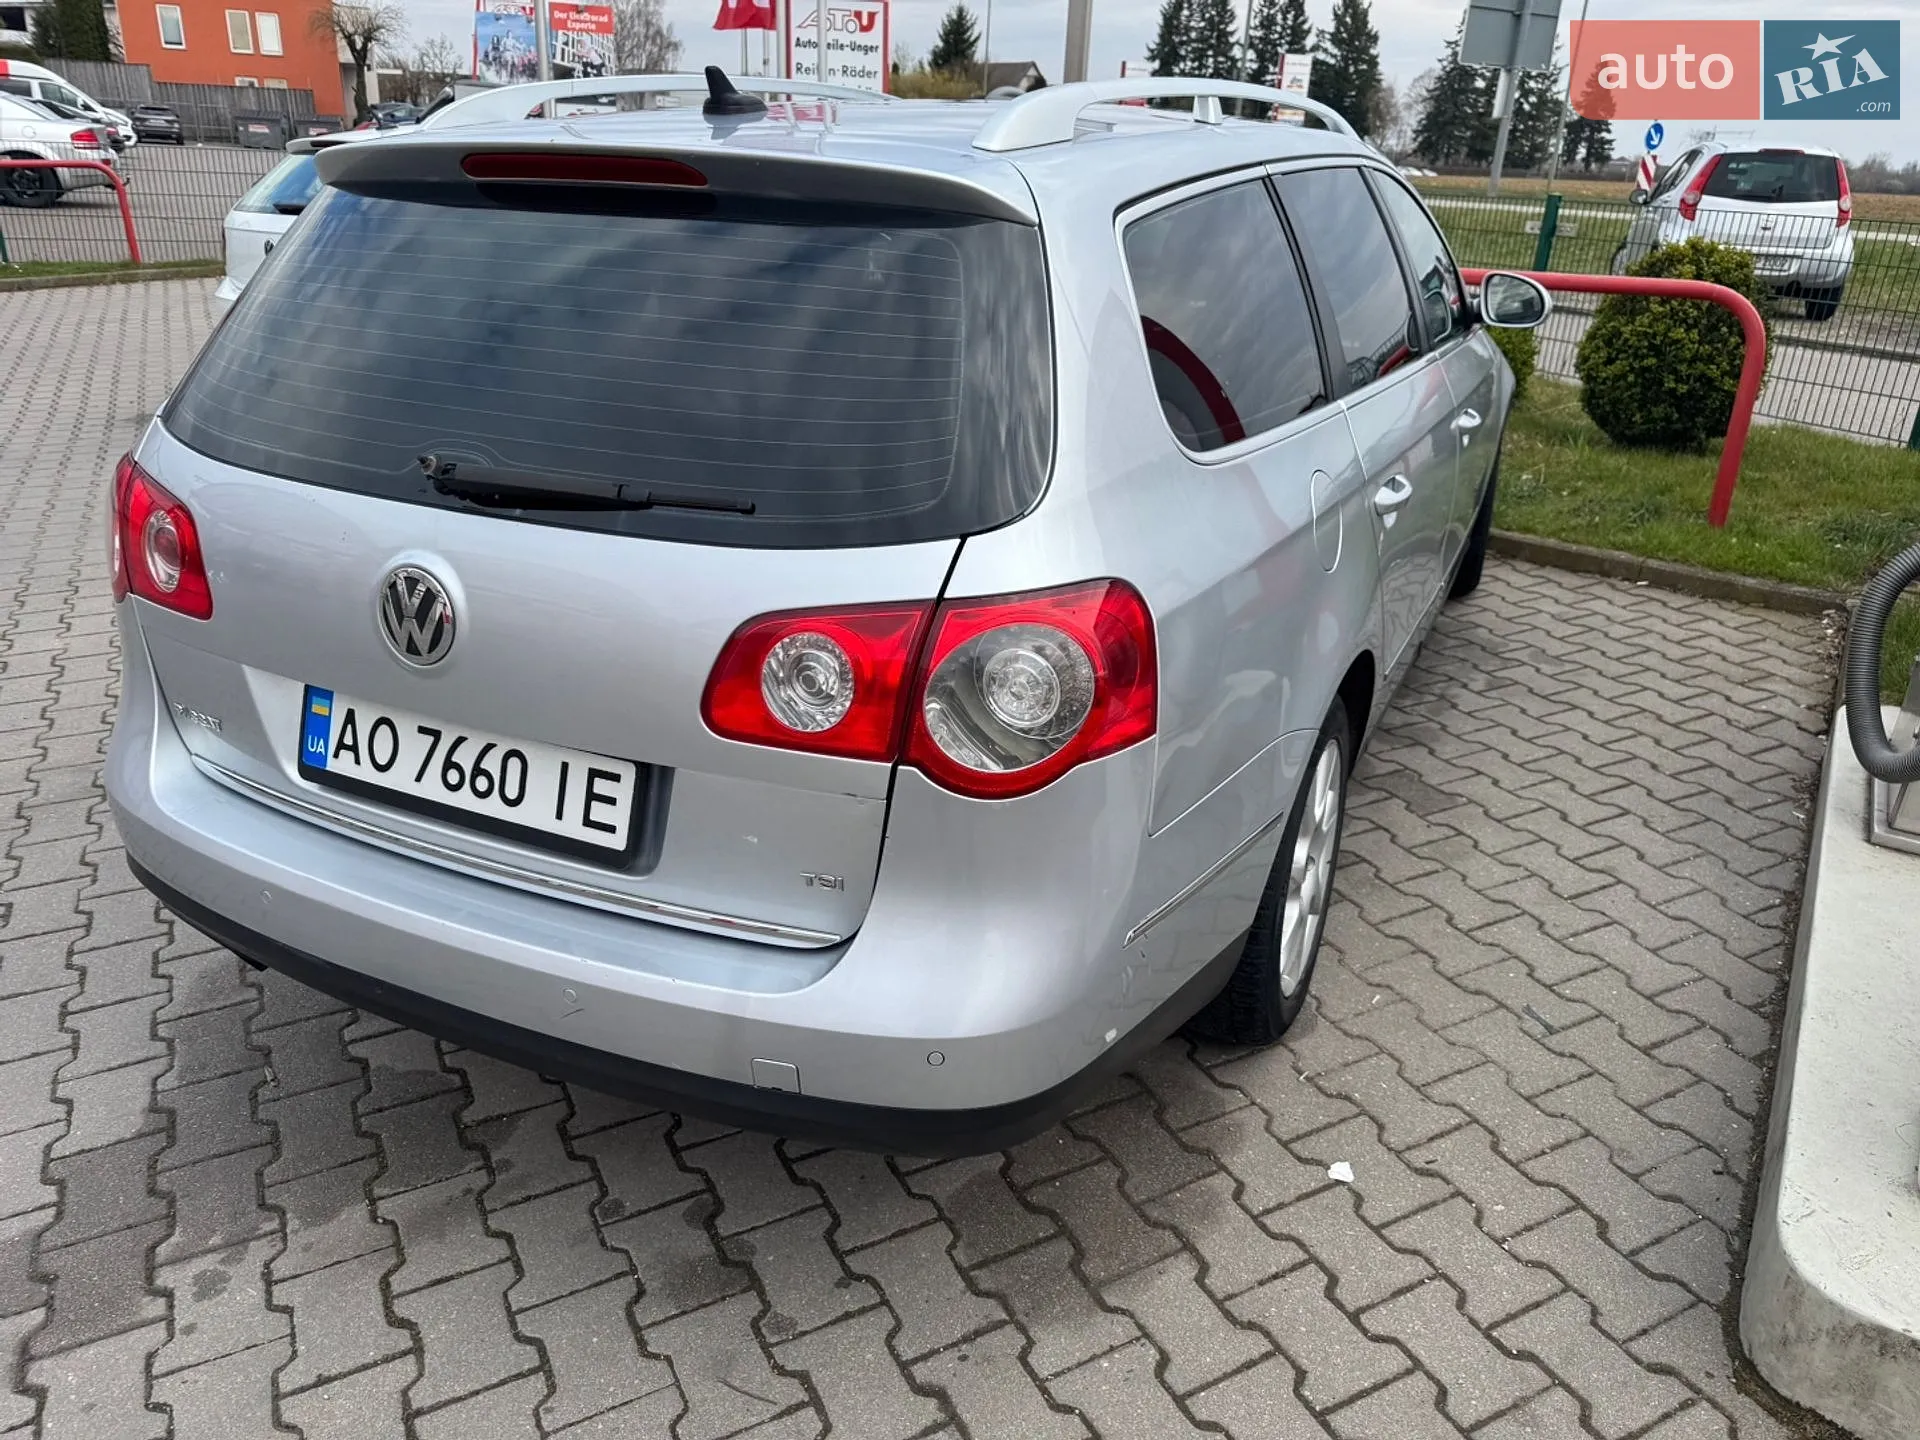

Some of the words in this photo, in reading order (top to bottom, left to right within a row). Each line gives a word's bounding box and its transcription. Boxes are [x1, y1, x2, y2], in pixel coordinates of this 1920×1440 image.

[795, 37, 879, 55] Autoeile-Unger
[308, 735, 326, 756] UA
[332, 708, 400, 773] AO
[414, 725, 528, 808] 7660
[555, 760, 622, 835] IE
